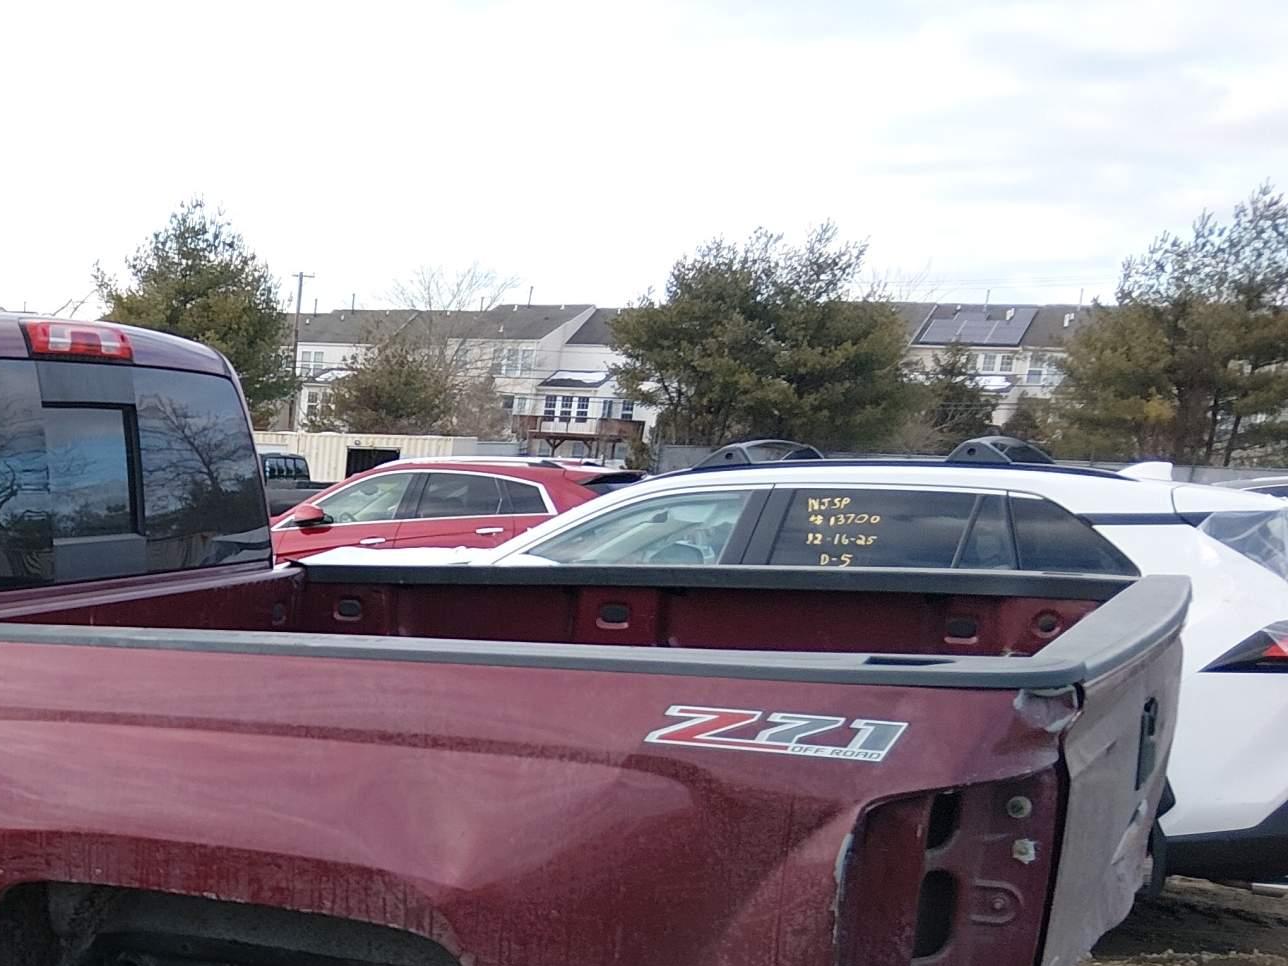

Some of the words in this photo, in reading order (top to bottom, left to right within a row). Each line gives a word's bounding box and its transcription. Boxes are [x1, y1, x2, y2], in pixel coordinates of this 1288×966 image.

[807, 497, 852, 512] NJSP
[829, 513, 881, 526] 13700
[805, 532, 878, 545] 12-16-25
[819, 553, 854, 567] D-5
[643, 704, 909, 755] Z71
[790, 745, 826, 755] OFF
[830, 748, 882, 760] ROAD
